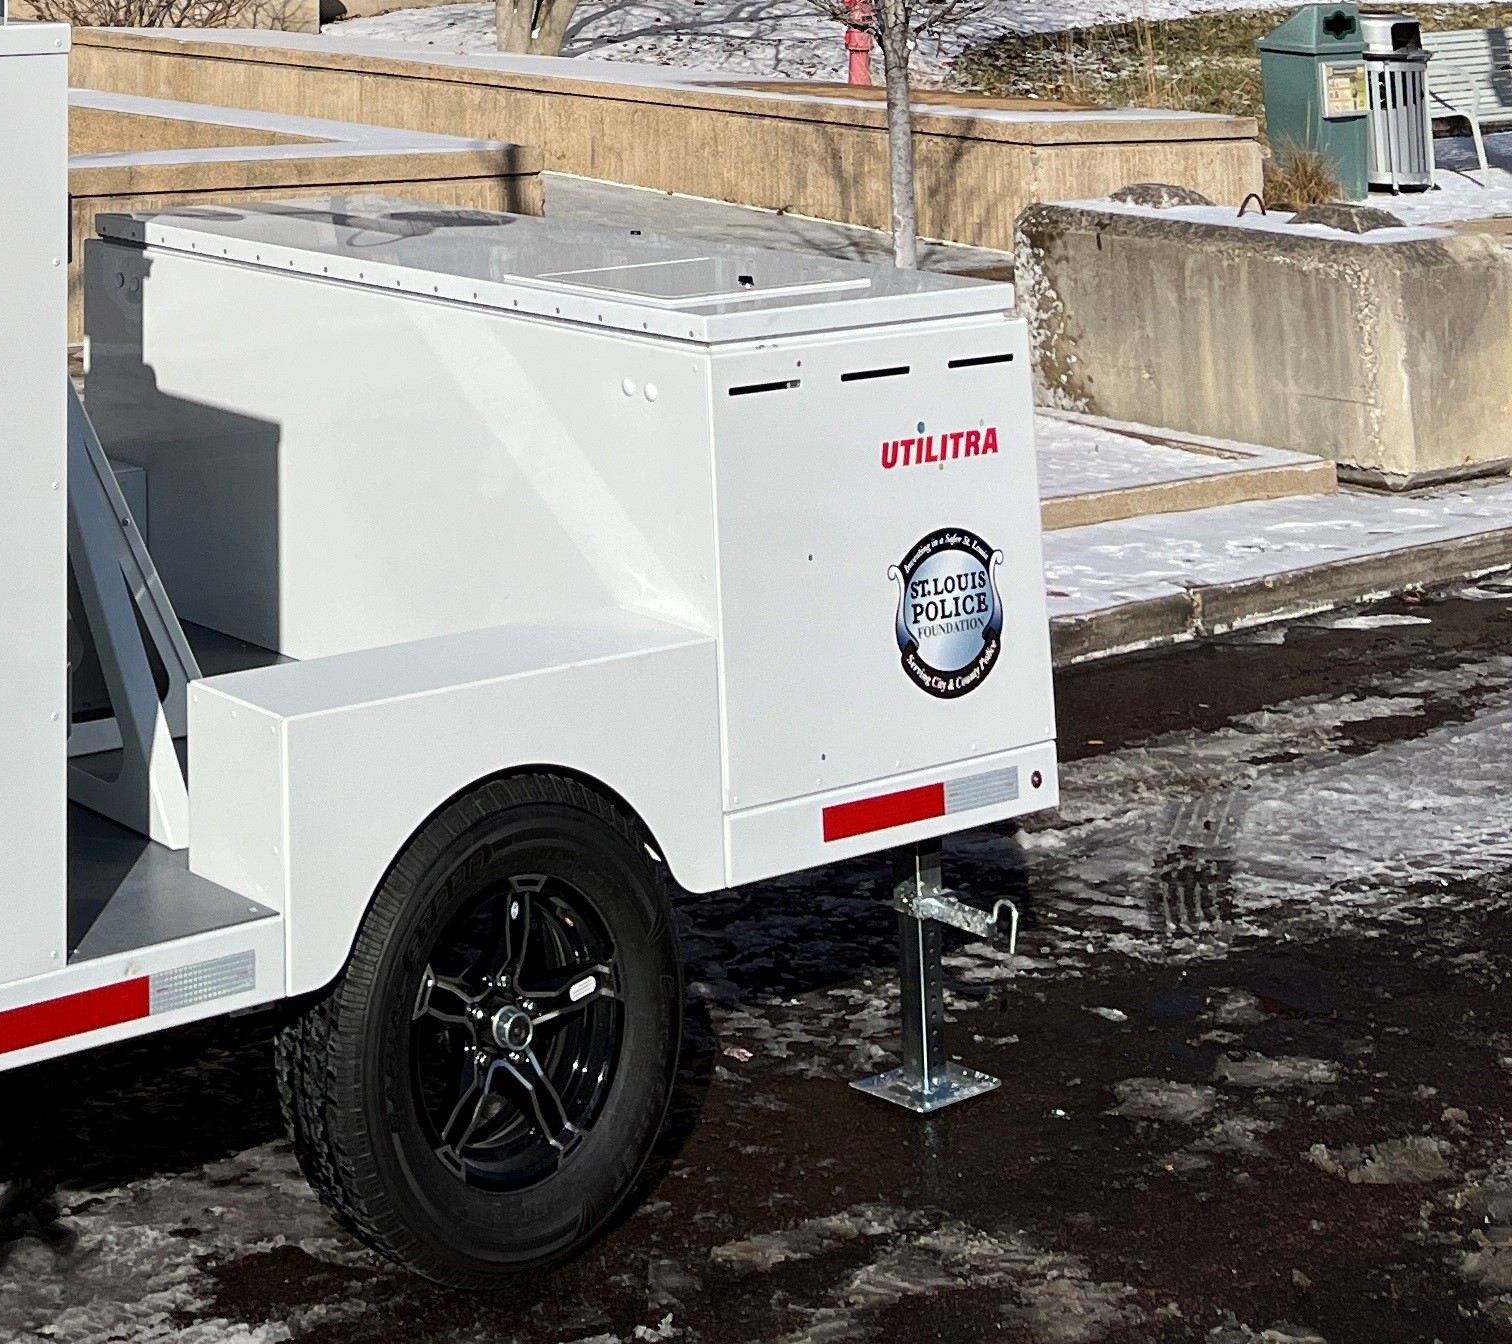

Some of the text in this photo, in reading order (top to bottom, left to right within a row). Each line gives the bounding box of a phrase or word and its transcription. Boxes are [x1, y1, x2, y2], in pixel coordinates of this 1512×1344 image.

[881, 427, 998, 469] UTILITRA
[911, 592, 988, 624] POLICE
[917, 616, 986, 639] FOUNDATION
[906, 654, 931, 687] Serving
[932, 676, 946, 692] City
[955, 666, 980, 688] County
[979, 639, 997, 670] Police
